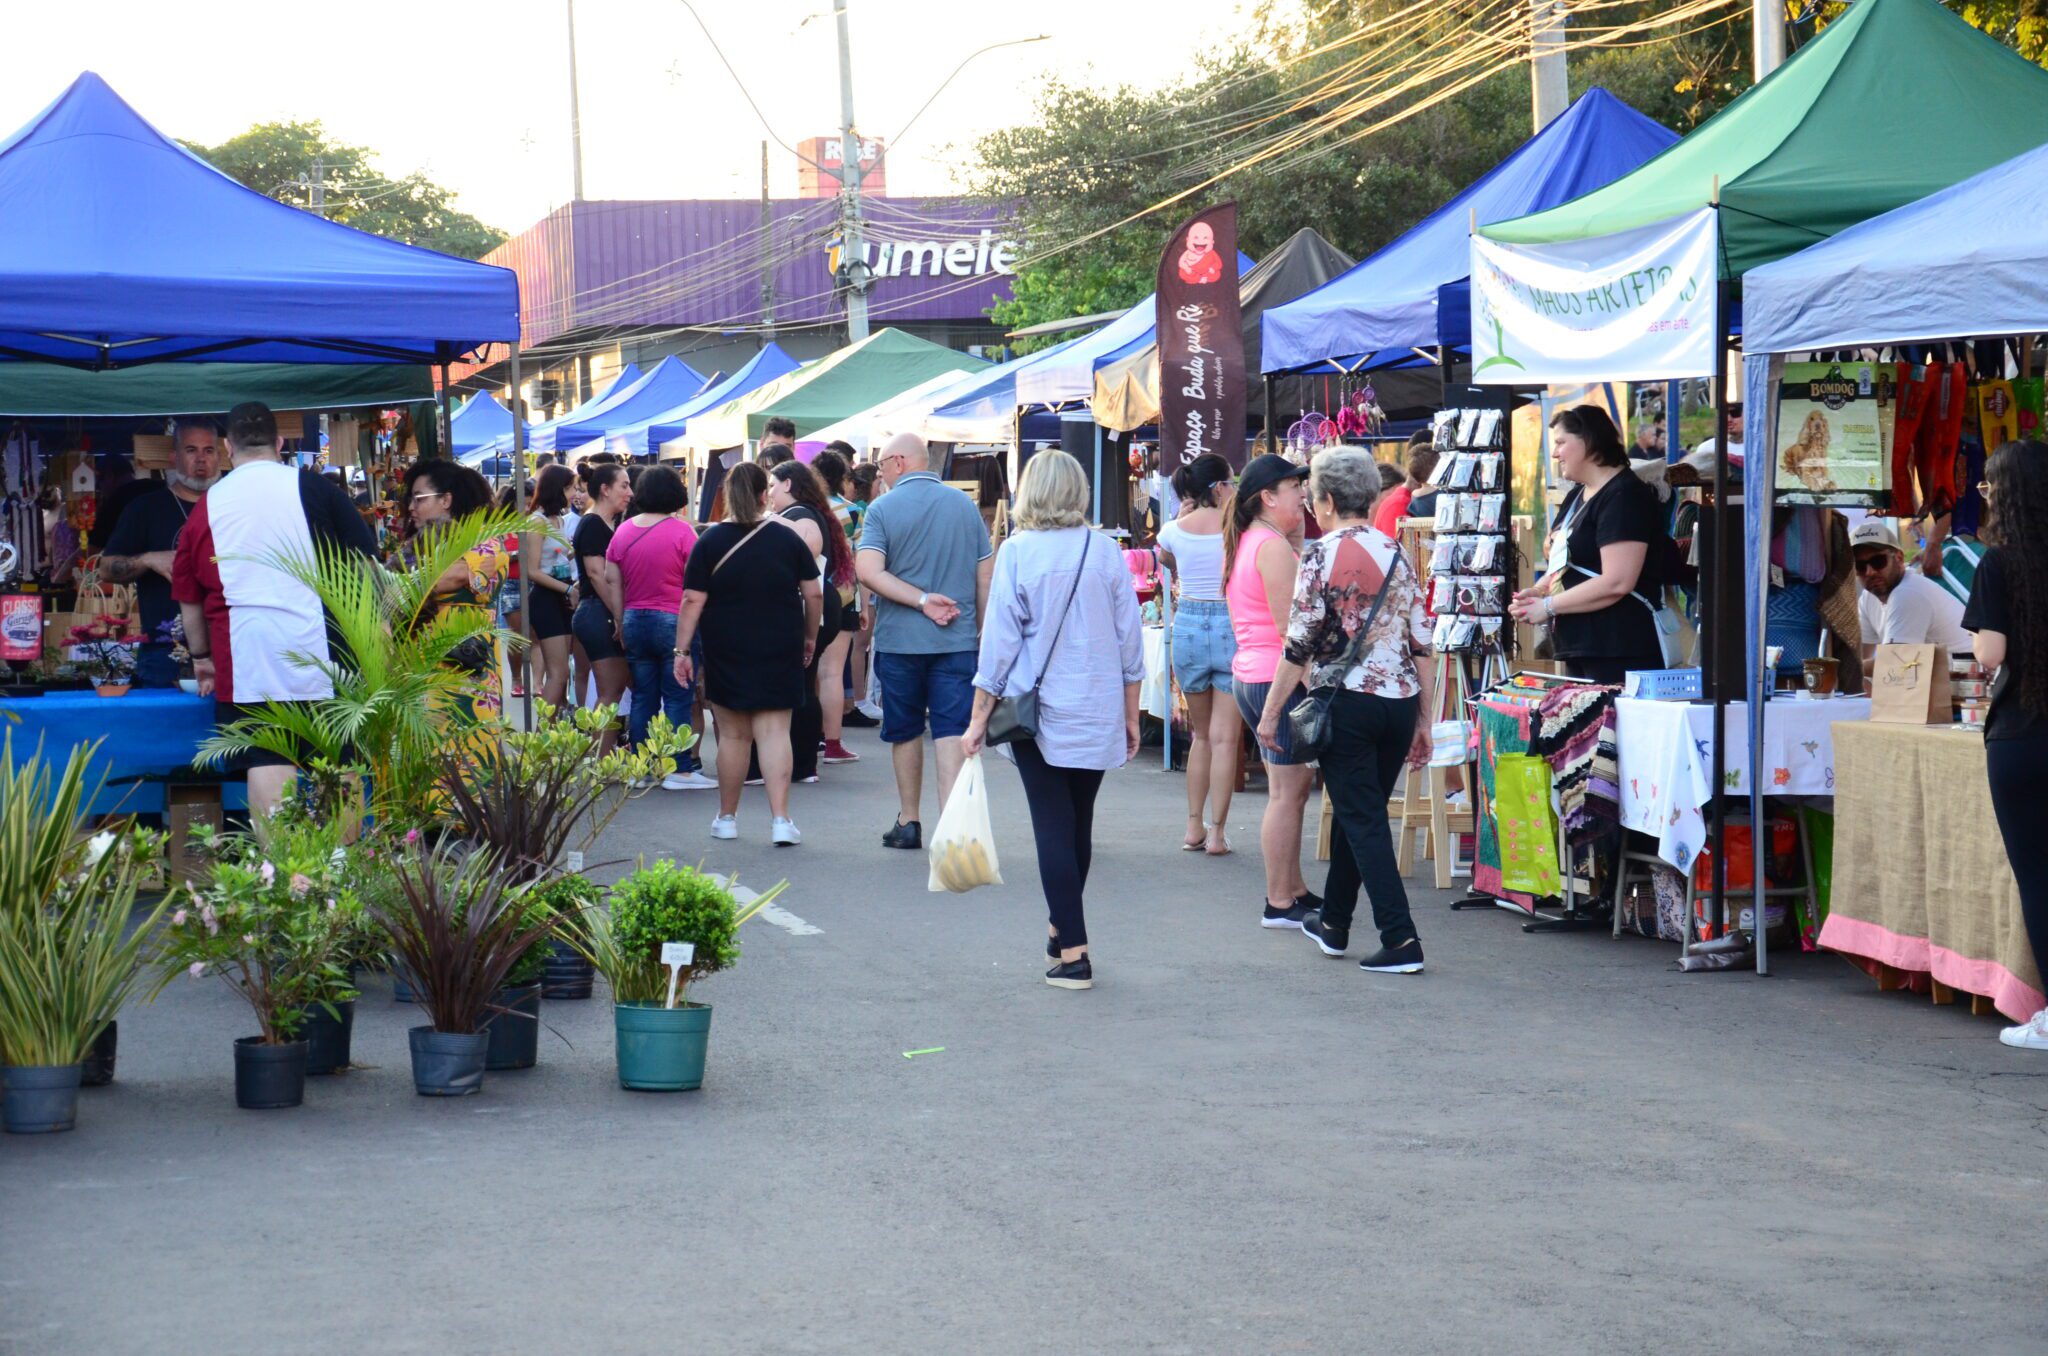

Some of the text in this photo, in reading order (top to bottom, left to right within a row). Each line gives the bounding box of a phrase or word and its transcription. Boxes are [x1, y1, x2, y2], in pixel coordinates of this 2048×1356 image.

[825, 229, 1019, 276] tumele
[1176, 303, 1203, 322] Ri
[1185, 324, 1214, 354] que
[1181, 356, 1206, 400] Buda
[1811, 383, 1855, 397] BOMDOG
[3, 598, 40, 615] CLASSIC
